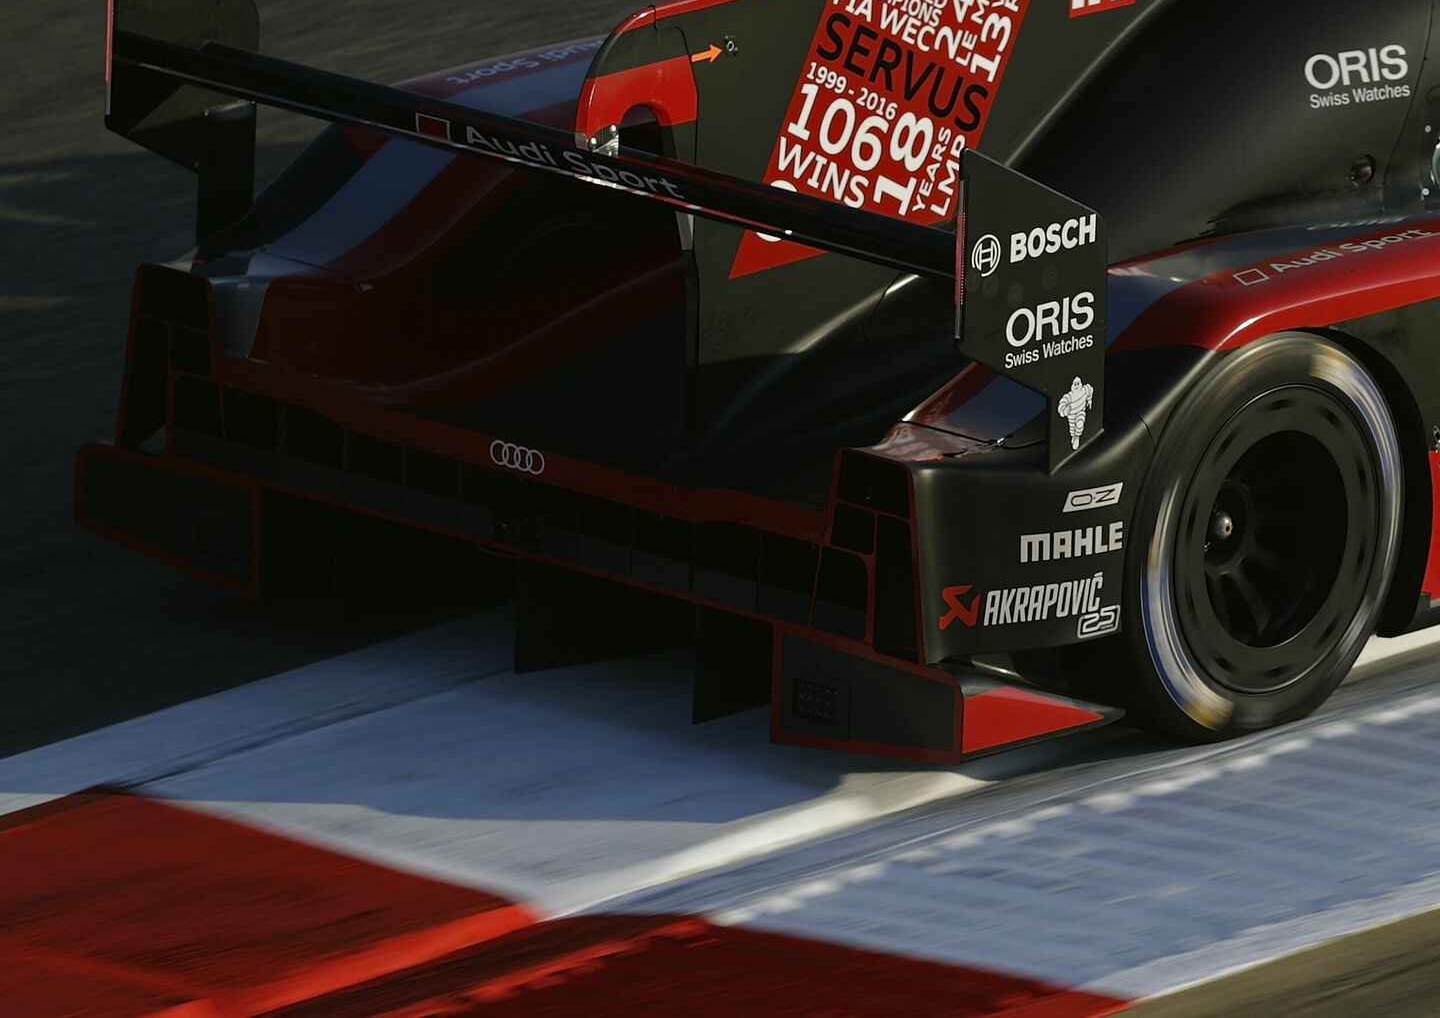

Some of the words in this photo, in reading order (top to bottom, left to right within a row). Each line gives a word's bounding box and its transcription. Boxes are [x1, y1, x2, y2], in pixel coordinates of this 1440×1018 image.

[880, 3, 936, 52] WEC
[955, 30, 978, 67] LE
[969, 12, 1012, 82] 13
[446, 57, 540, 85] Sport
[806, 62, 847, 94] 1999
[856, 87, 898, 120] 2016
[816, 13, 989, 133] SERVUS
[1304, 44, 1408, 90] ORIS
[1310, 92, 1350, 109] Swiss
[1352, 84, 1411, 103] Watches
[787, 83, 889, 172] 106
[466, 125, 558, 166] Audi
[562, 150, 685, 199] Sport
[777, 136, 869, 208] WINS
[873, 111, 934, 216] 18
[911, 126, 952, 212] YEARS
[930, 134, 966, 216] LMP
[1010, 213, 1097, 263] BOSCH
[1270, 249, 1343, 273] Audi
[1338, 228, 1432, 253] Sport
[1005, 291, 1095, 347] ORIS
[1005, 348, 1039, 369] Swiss
[1042, 335, 1093, 359] Watches
[1020, 521, 1123, 563] MAHLE
[1082, 605, 1116, 633] 25
